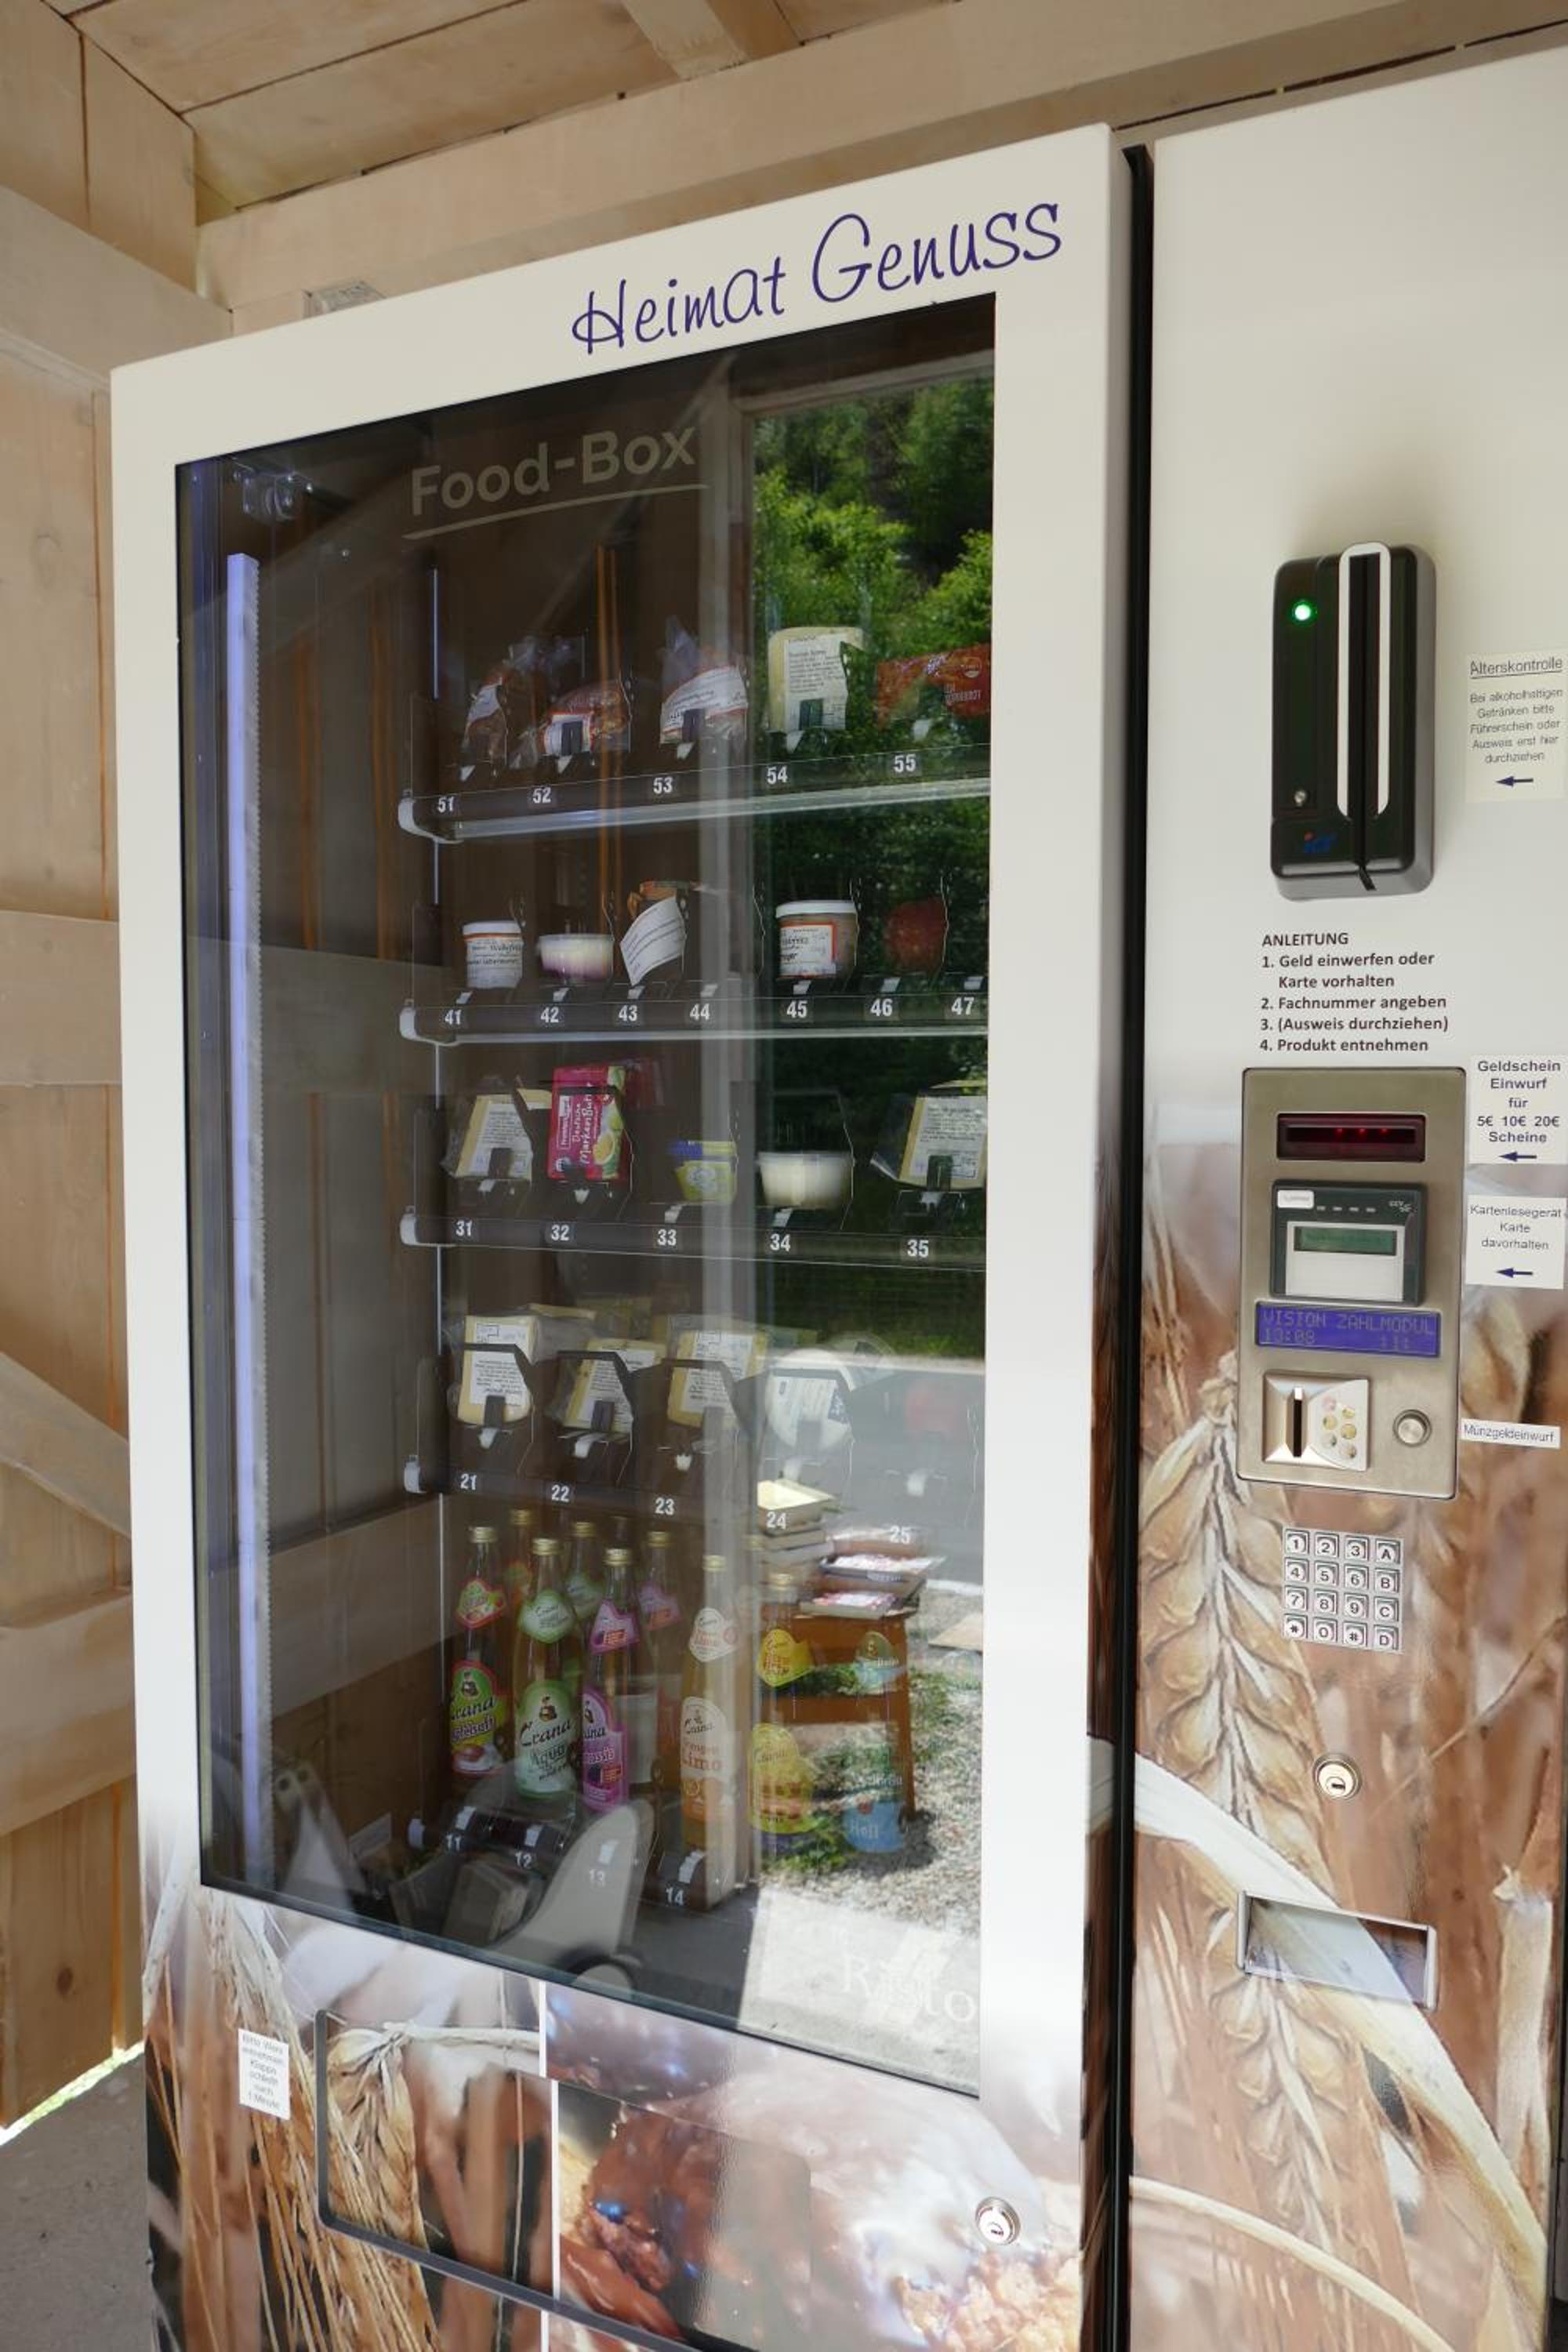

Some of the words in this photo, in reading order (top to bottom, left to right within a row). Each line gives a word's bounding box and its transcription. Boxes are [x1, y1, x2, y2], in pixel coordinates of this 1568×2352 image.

[572, 256, 786, 354] Heimat
[811, 201, 1062, 303] Genuss
[411, 426, 696, 516] Food-Box
[1470, 656, 1563, 676] Alterskontrolle
[1470, 693, 1486, 704] Bei
[1537, 720, 1561, 730] oder
[437, 796, 456, 814] 51
[532, 786, 552, 804] 52
[652, 776, 674, 795] 53
[766, 766, 788, 785] 54
[893, 753, 916, 773] 55
[1261, 932, 1349, 947] ANLEITUNG
[1261, 956, 1275, 968] 1.
[1279, 954, 1313, 968] Geld
[1317, 953, 1394, 967] einwerfen
[1398, 952, 1436, 966] oder
[1279, 975, 1318, 989] Karte
[1321, 975, 1395, 988] vorhalten
[444, 1009, 462, 1025] 41
[540, 1007, 560, 1024] 42
[619, 1004, 638, 1022] 43
[690, 1004, 710, 1021] 44
[786, 1000, 808, 1018] 45
[870, 998, 893, 1017] 46
[951, 996, 975, 1015] 47
[1261, 997, 1274, 1010] 2.
[1278, 996, 1376, 1010] Fachnummer
[1380, 995, 1447, 1011] angeben
[1260, 1018, 1273, 1031] 3.
[1278, 1017, 1345, 1033] (Ausweis
[1348, 1016, 1449, 1033] durchziehen)
[1259, 1040, 1272, 1051] 4.
[1277, 1038, 1337, 1051] Produkt
[1340, 1038, 1429, 1051] entnehmen
[1477, 1060, 1562, 1073] Geldschein
[1490, 1077, 1548, 1089] Einwurf
[1508, 1098, 1528, 1108] für
[1477, 1116, 1494, 1127] 5€
[1502, 1116, 1526, 1127] 10€
[1534, 1116, 1561, 1127] 20€
[1489, 1131, 1547, 1143] Scheine
[456, 1220, 473, 1237] 31
[551, 1225, 570, 1242] 32
[657, 1229, 677, 1247] 33
[769, 1233, 791, 1252] 34
[906, 1239, 930, 1258] 35
[1481, 1238, 1549, 1250] davorhalten
[1261, 1308, 1327, 1329] VISION
[460, 1473, 477, 1490] 21
[550, 1484, 570, 1503] 22
[655, 1497, 675, 1515] 23
[766, 1511, 787, 1530] 24
[889, 1525, 911, 1544] 25
[1293, 1539, 1299, 1550] 1
[1321, 1541, 1330, 1554] 2
[1351, 1545, 1360, 1557] 3
[1381, 1548, 1392, 1561] A
[1290, 1567, 1300, 1578] 4
[1320, 1570, 1329, 1582] 5
[1351, 1574, 1359, 1586] 6
[1381, 1577, 1390, 1589] B
[1290, 1594, 1299, 1606] 7
[1319, 1599, 1329, 1610] 8
[1350, 1602, 1359, 1614] 9
[1379, 1606, 1390, 1618] C
[1379, 1635, 1390, 1646] D
[666, 1887, 684, 1906] 14
